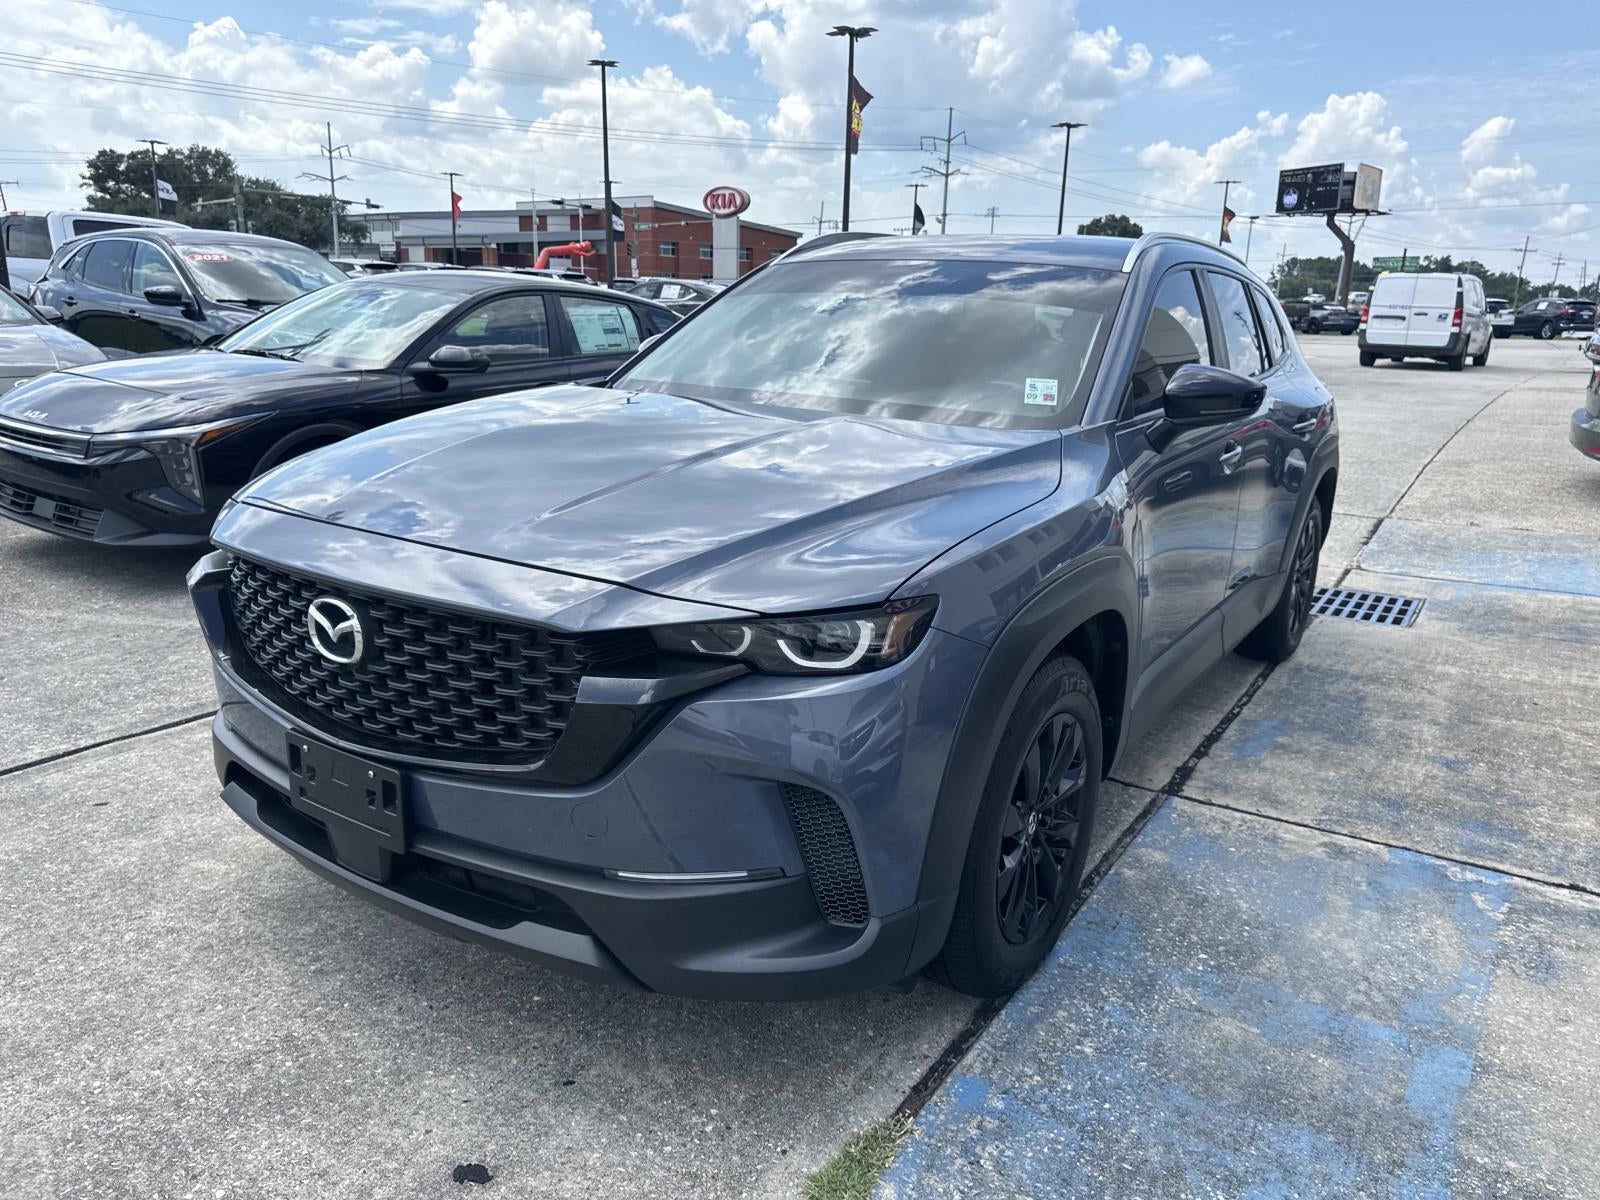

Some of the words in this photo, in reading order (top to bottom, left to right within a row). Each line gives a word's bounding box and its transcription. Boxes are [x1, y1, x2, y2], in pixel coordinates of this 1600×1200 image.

[709, 192, 738, 210] KIA
[1026, 392, 1038, 400] 09
[1043, 393, 1055, 401] 25
